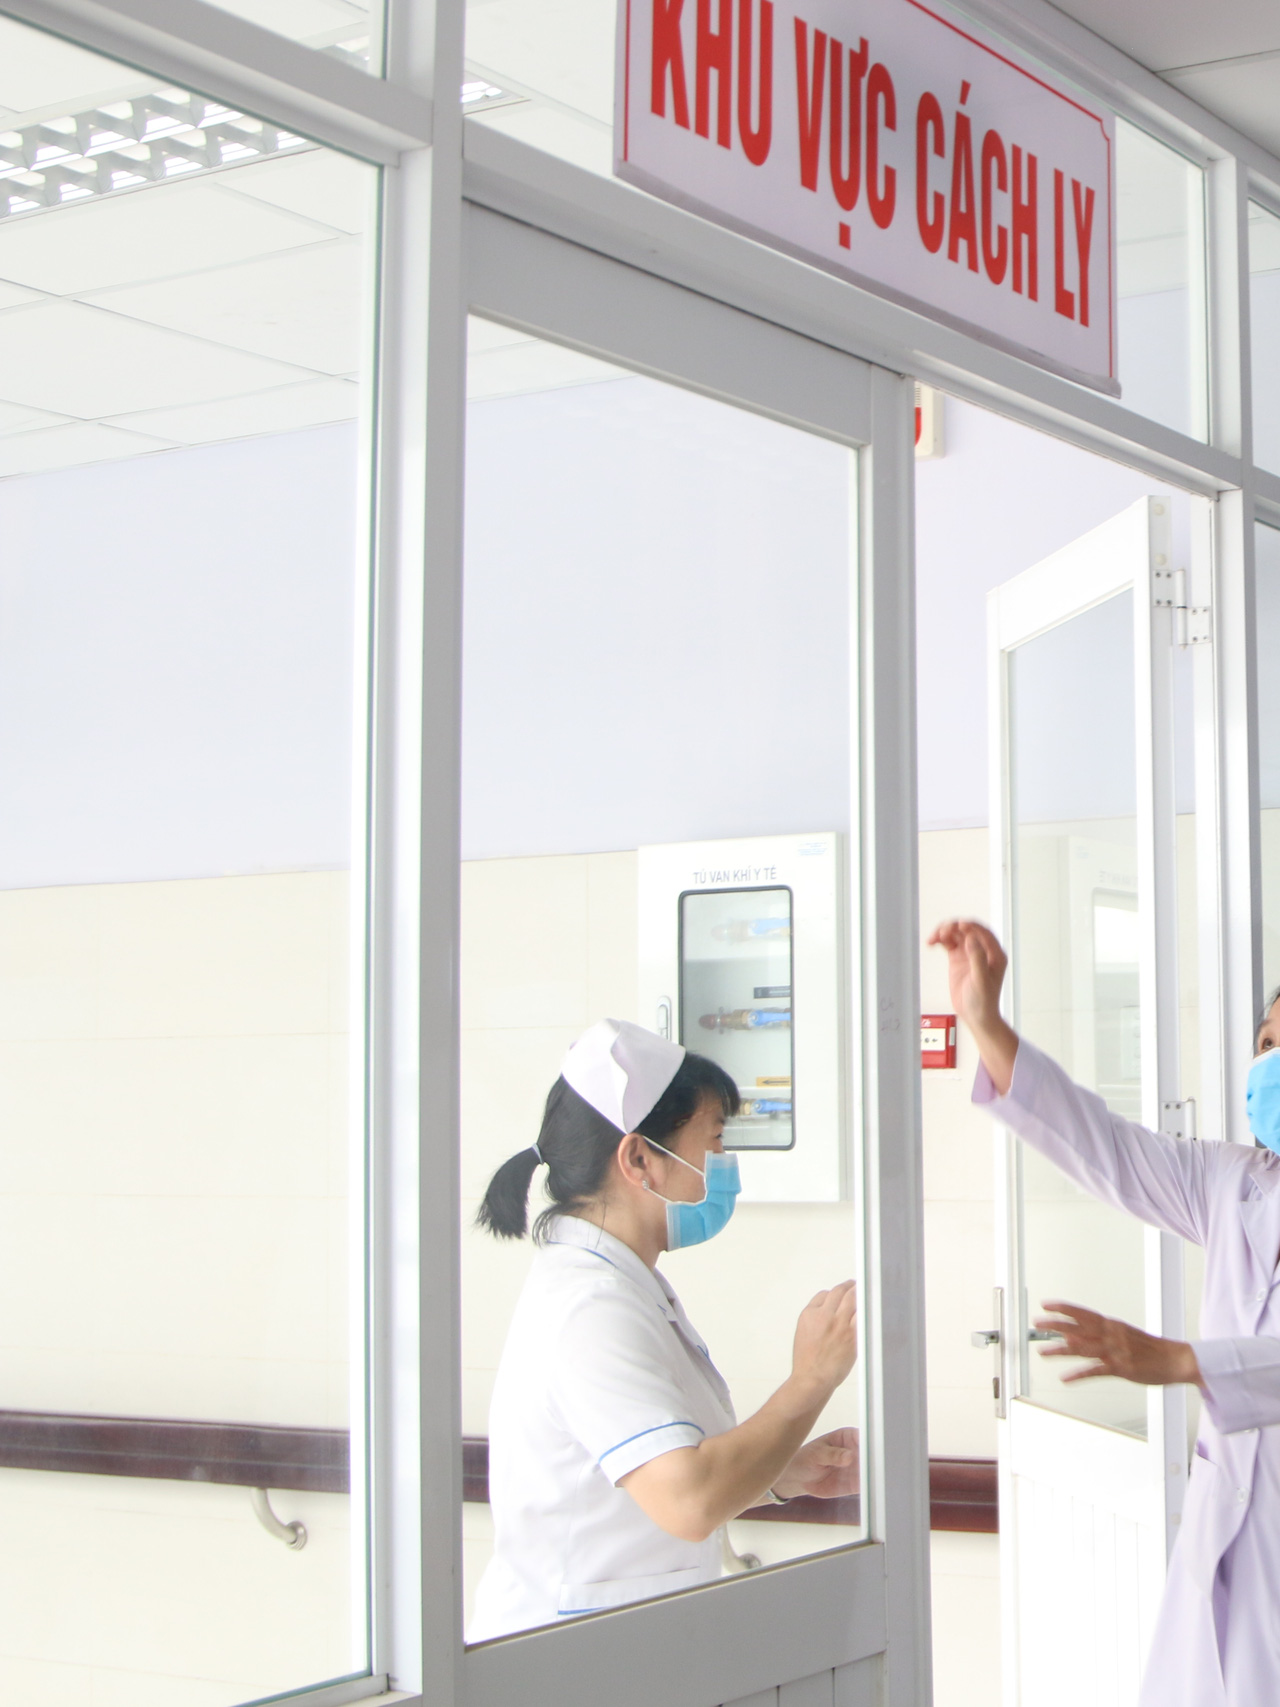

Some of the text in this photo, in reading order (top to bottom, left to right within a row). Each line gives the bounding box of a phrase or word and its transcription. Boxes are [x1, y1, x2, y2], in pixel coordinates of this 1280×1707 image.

[651, 0, 1095, 328] KHU VỰC CÁCH LY
[710, 869, 731, 884] VAN
[733, 865, 752, 883] KHÍ
[754, 868, 762, 881] Y
